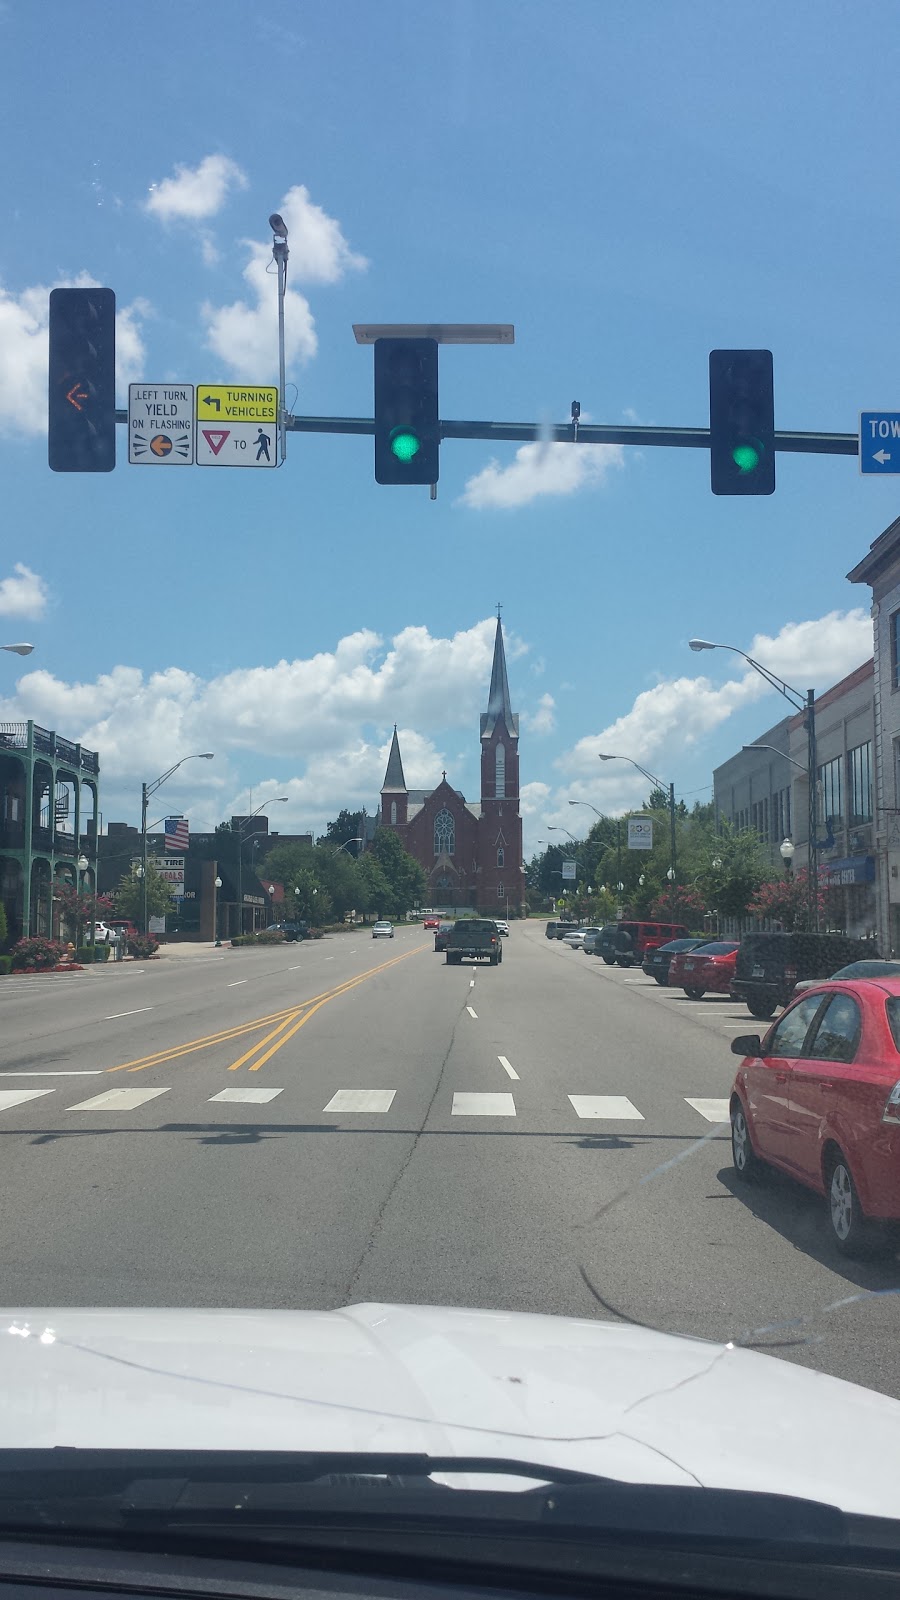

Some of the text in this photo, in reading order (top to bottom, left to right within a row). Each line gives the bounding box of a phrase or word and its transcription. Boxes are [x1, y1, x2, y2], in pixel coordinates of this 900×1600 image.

[137, 391, 186, 400] LEFT TURN
[227, 392, 273, 402] TURNING
[145, 404, 178, 416] YIELD
[225, 407, 274, 417] VEHICLES
[132, 420, 191, 430] ON FLASHING
[234, 440, 247, 450] TO
